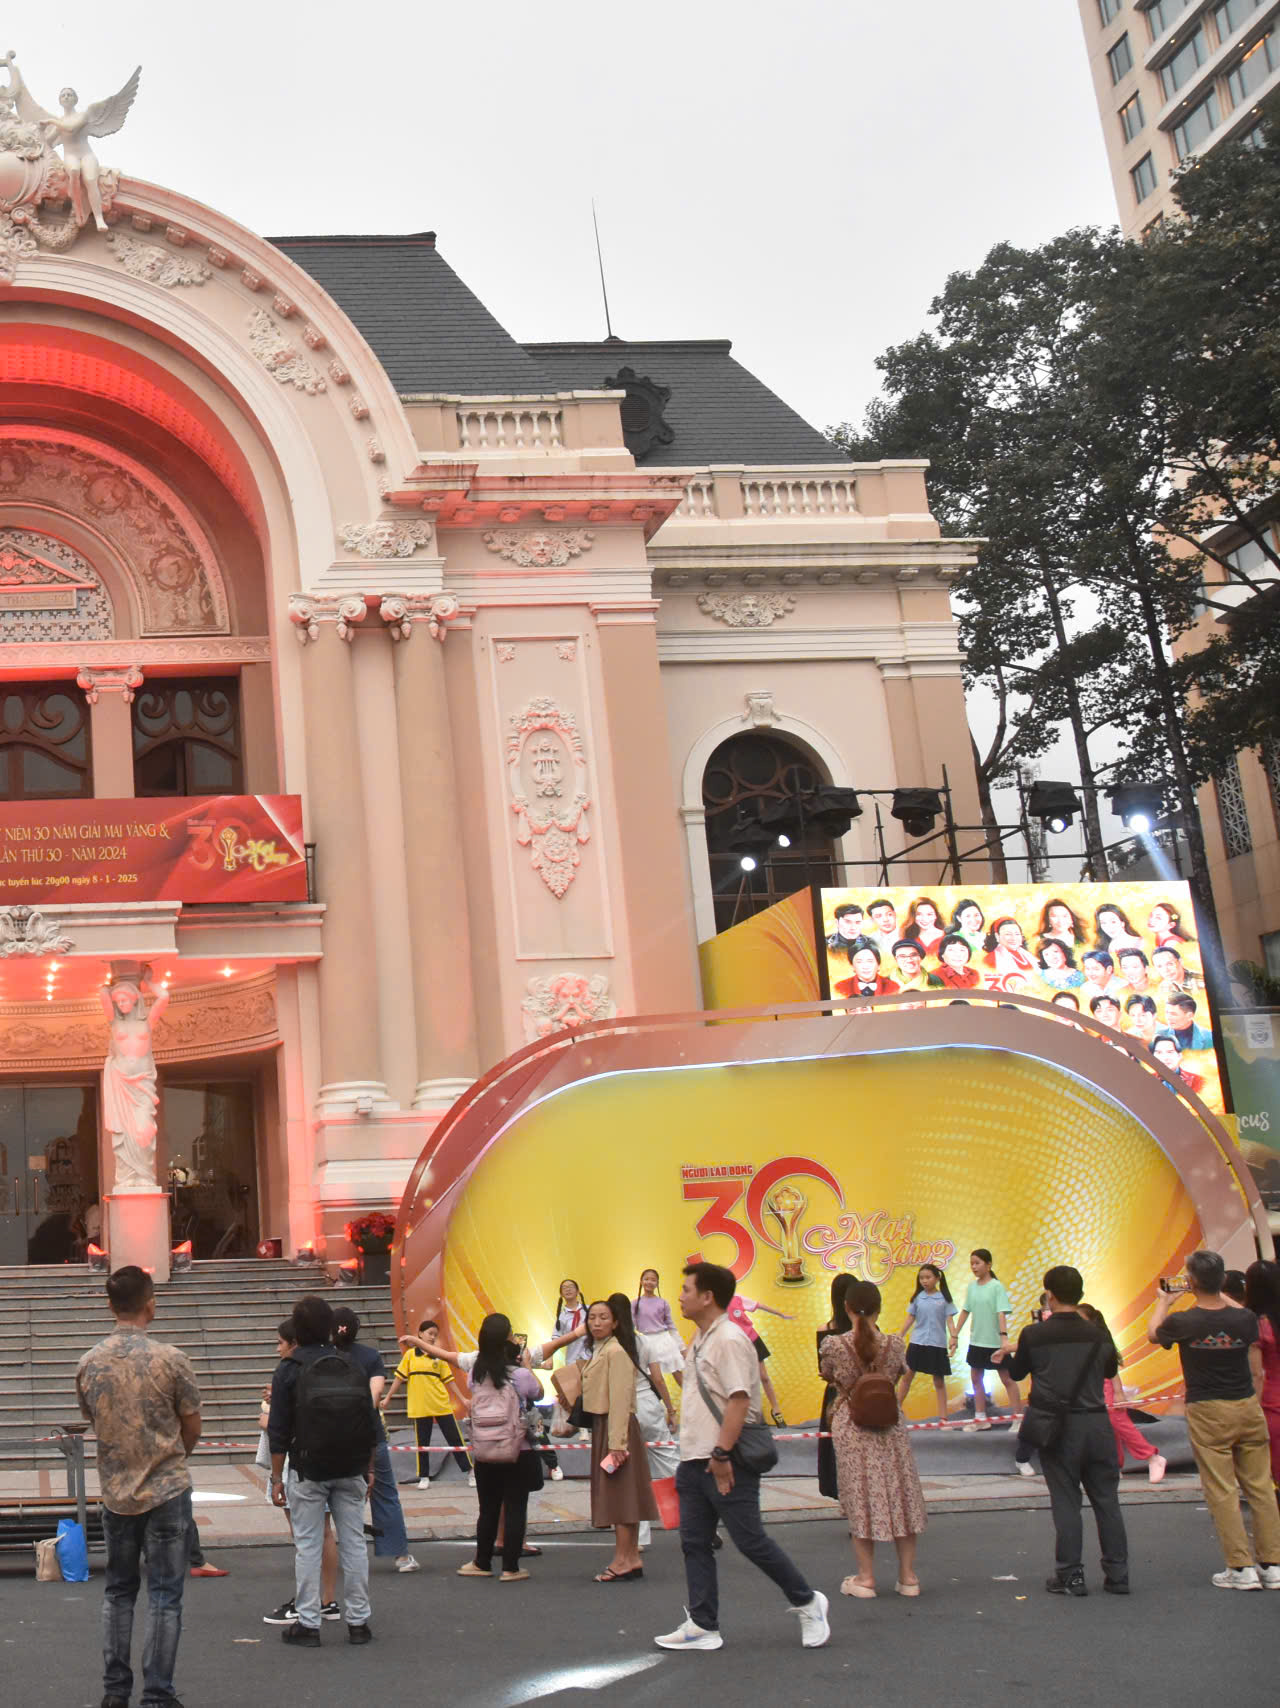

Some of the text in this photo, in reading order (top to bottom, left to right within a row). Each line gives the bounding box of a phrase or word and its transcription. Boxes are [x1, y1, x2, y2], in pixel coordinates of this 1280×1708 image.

[33, 827, 50, 841] 30
[104, 824, 122, 838] MAI
[160, 823, 171, 839] &
[46, 848, 63, 862] 30
[98, 846, 127, 860] 2024
[117, 873, 138, 883] 2025
[1236, 1111, 1270, 1134] cus
